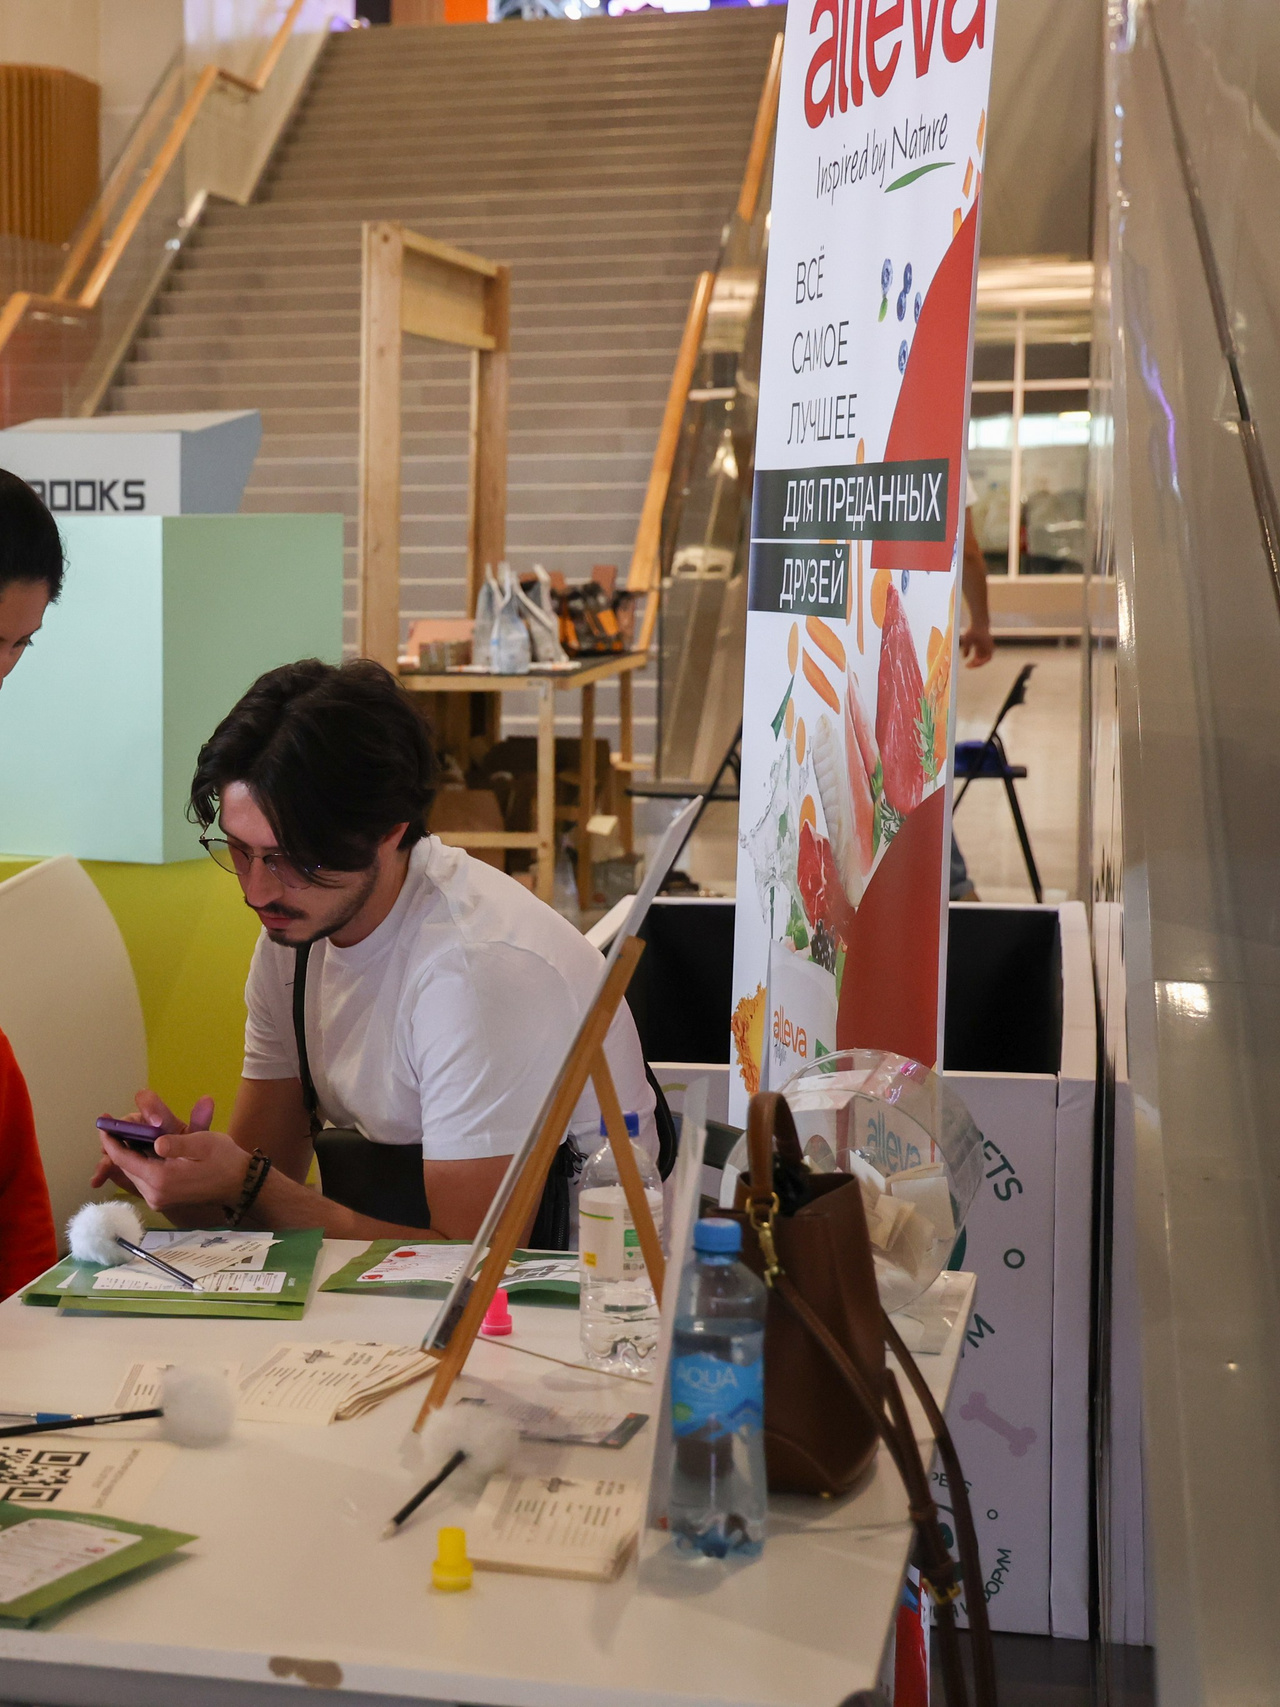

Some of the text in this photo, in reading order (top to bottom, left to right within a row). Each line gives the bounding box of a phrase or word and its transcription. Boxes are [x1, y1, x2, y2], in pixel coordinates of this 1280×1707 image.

[804, 0, 984, 129] alleva
[816, 113, 948, 206] Inspired by Nature
[795, 245, 825, 304] ВСЁ
[791, 320, 850, 374] САМОЕ
[787, 393, 858, 445] ЛУЧШЕЕ
[783, 472, 943, 532] ДЛЯ ПРЕДАННЫХ
[779, 548, 845, 609] ДРУЗЕЙ
[773, 1004, 807, 1059] alleva
